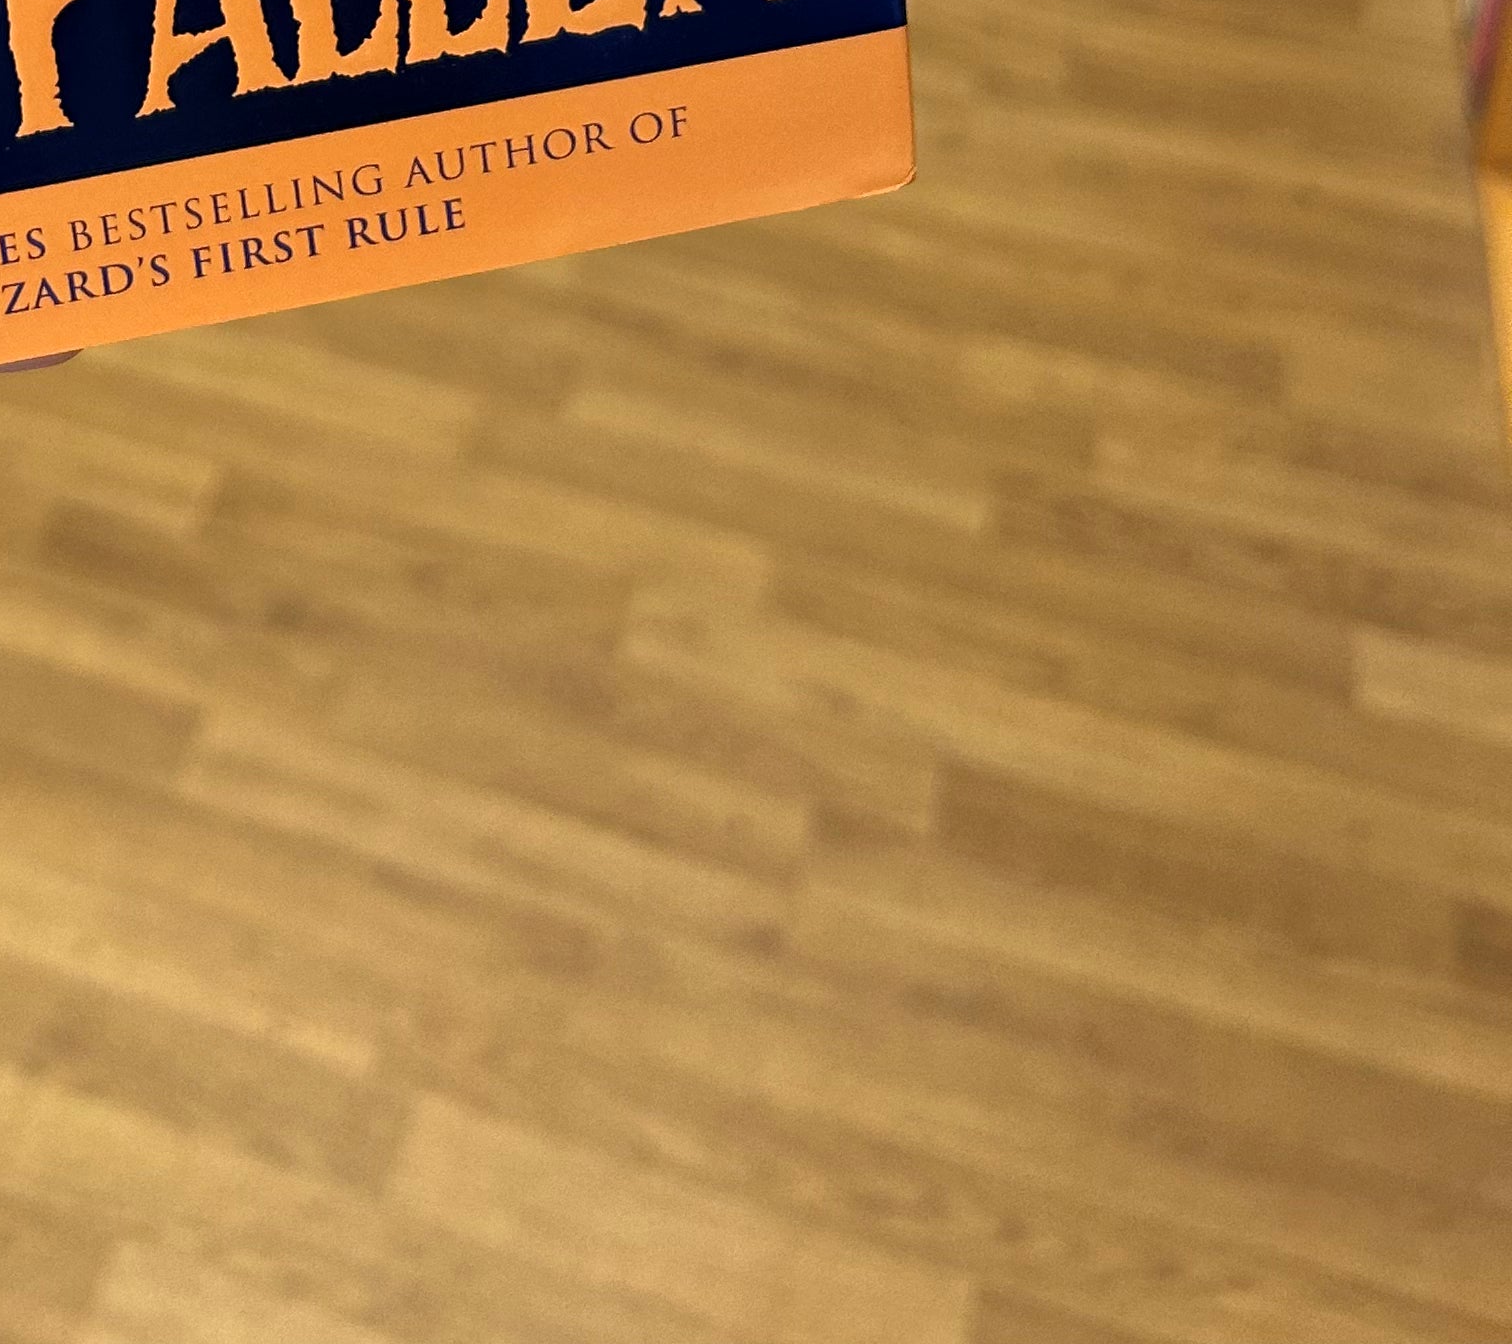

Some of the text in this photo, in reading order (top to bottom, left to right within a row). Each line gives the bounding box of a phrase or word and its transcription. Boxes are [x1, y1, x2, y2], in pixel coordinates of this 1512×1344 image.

[69, 163, 383, 252] BESTSELLING
[404, 122, 614, 189] AUTHOR
[629, 106, 688, 145] OF
[191, 223, 326, 279] FIRST
[345, 197, 466, 250] RULE
